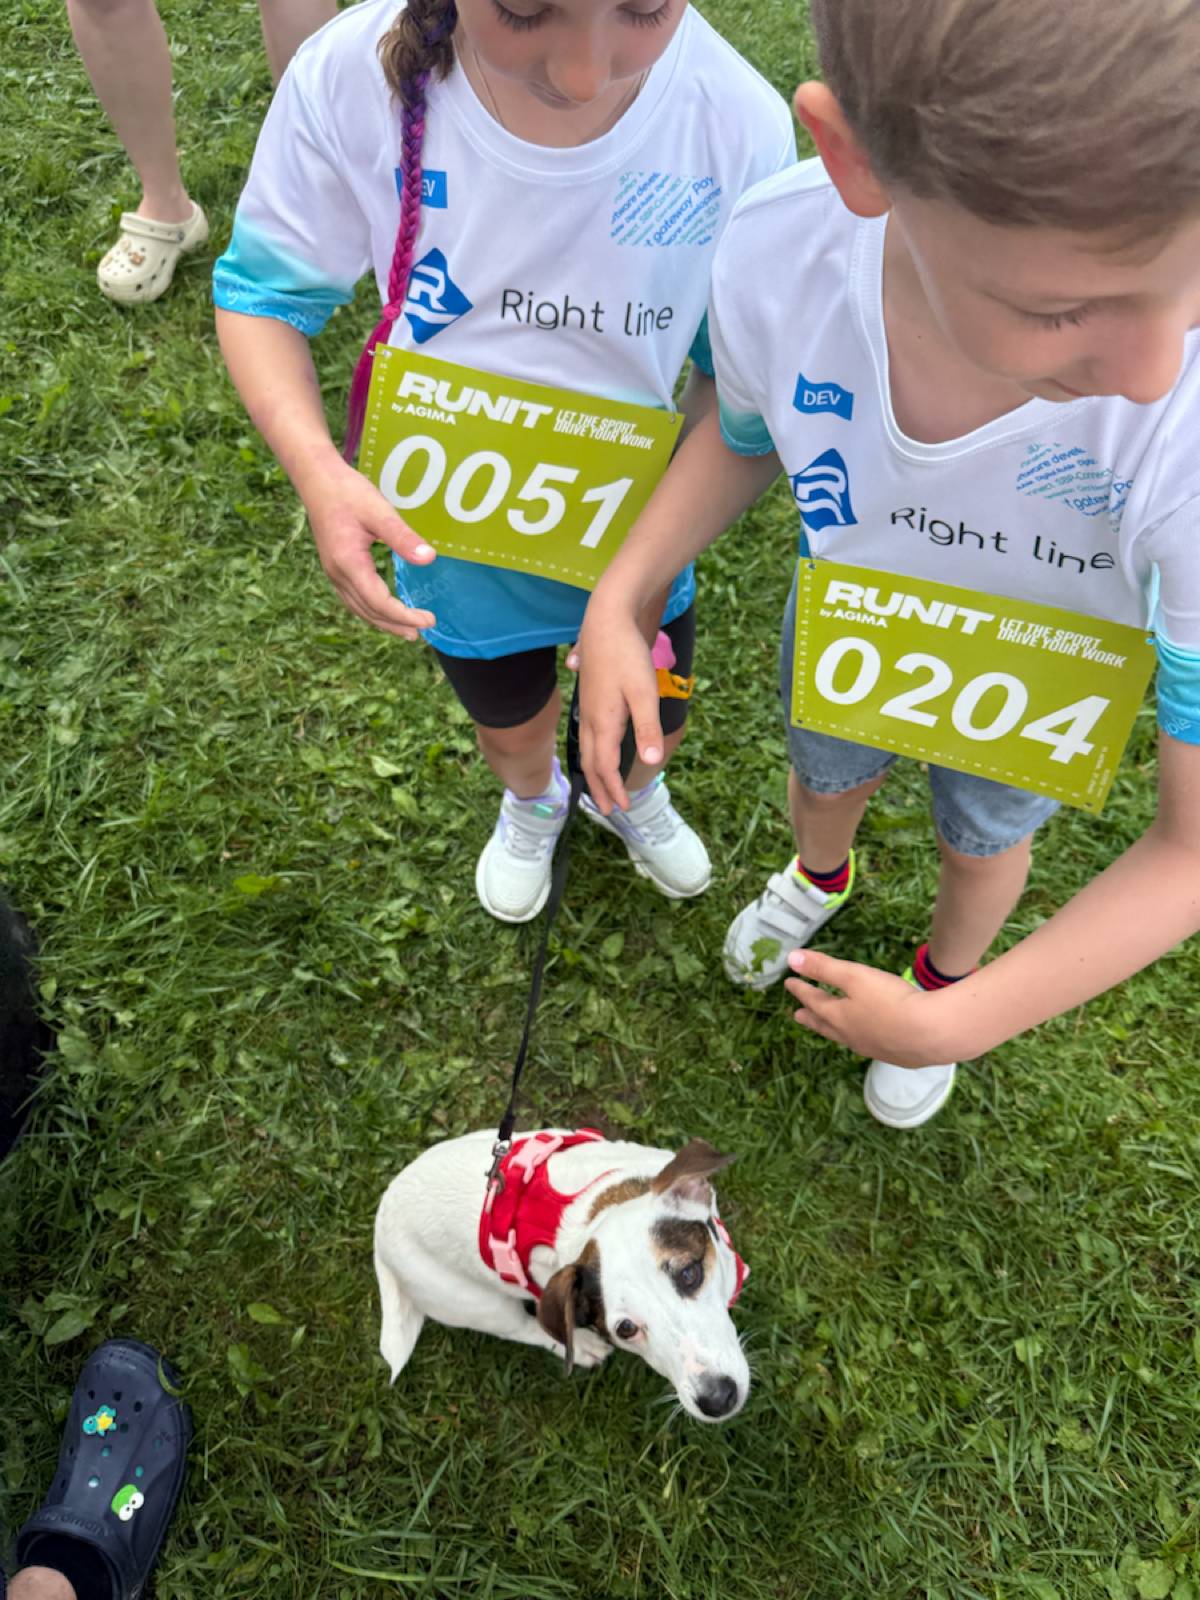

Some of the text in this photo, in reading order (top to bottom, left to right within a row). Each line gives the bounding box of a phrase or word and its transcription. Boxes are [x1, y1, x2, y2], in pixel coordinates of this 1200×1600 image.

[653, 194, 693, 244] gateway
[692, 176, 714, 196] Pay
[501, 288, 674, 337] Right line
[391, 402, 456, 426] by AGIMA
[396, 370, 554, 430] RUNIT
[803, 388, 841, 406] DEV
[553, 419, 655, 450] DRIVE YOUR WORK
[556, 409, 637, 435] LET THE SPORT
[379, 434, 634, 549] 0051
[891, 507, 1115, 574] Right line
[819, 608, 888, 629] by AGIMA
[824, 579, 996, 636] RUNIT
[996, 627, 1128, 669] DRIVE YOUR WORK
[999, 617, 1103, 650] LET THE SPORT
[814, 636, 1111, 765] 0204
